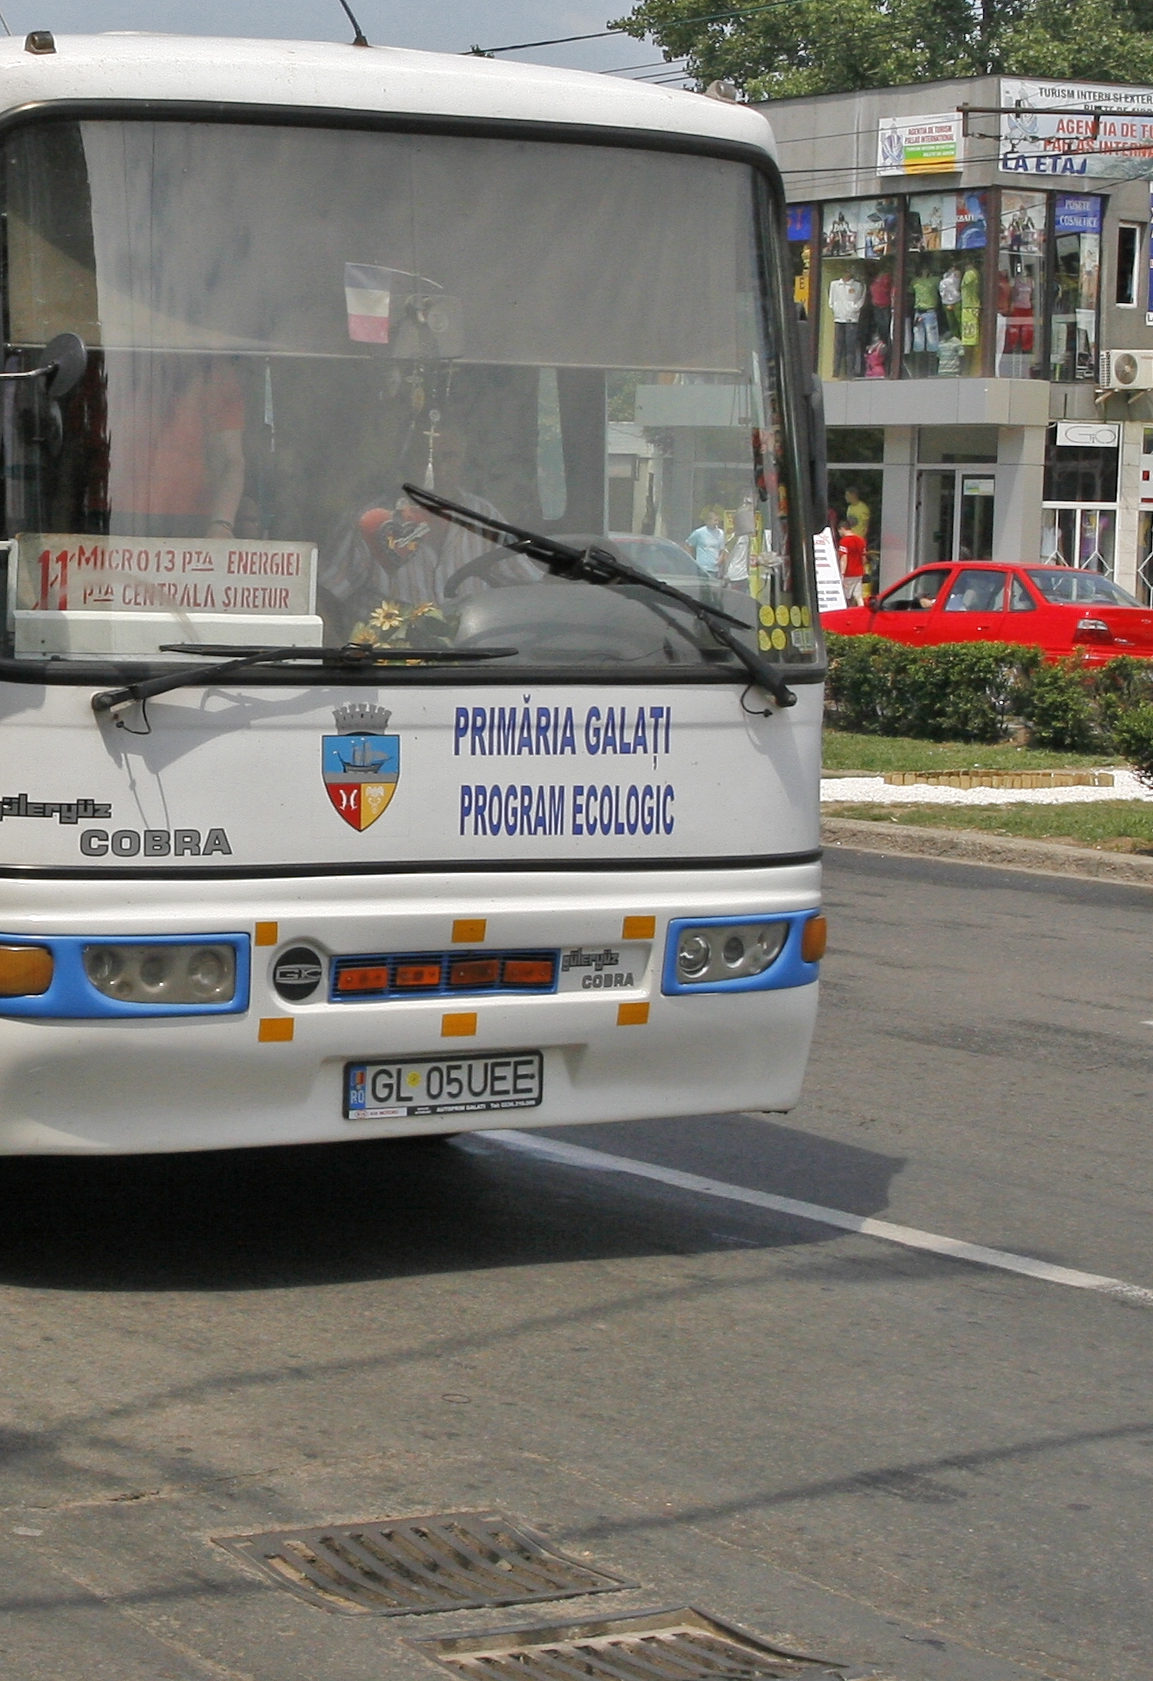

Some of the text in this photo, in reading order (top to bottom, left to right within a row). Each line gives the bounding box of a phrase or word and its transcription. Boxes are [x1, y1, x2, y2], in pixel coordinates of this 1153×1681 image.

[1039, 87, 1075, 99] TURISM
[1077, 89, 1109, 102] INTERN
[1121, 122, 1137, 138] DE
[1002, 153, 1087, 175] LA ETAJ
[227, 550, 301, 577] ENERGIEI
[122, 582, 216, 609] CENTRALA
[453, 693, 577, 757] PRIMĂRIA
[459, 784, 675, 836] PROGRAM ECOLOGIC
[79, 828, 232, 857] COBRA
[581, 972, 634, 989] COBRA
[350, 1090, 365, 1105] RO
[371, 1068, 413, 1103] GL
